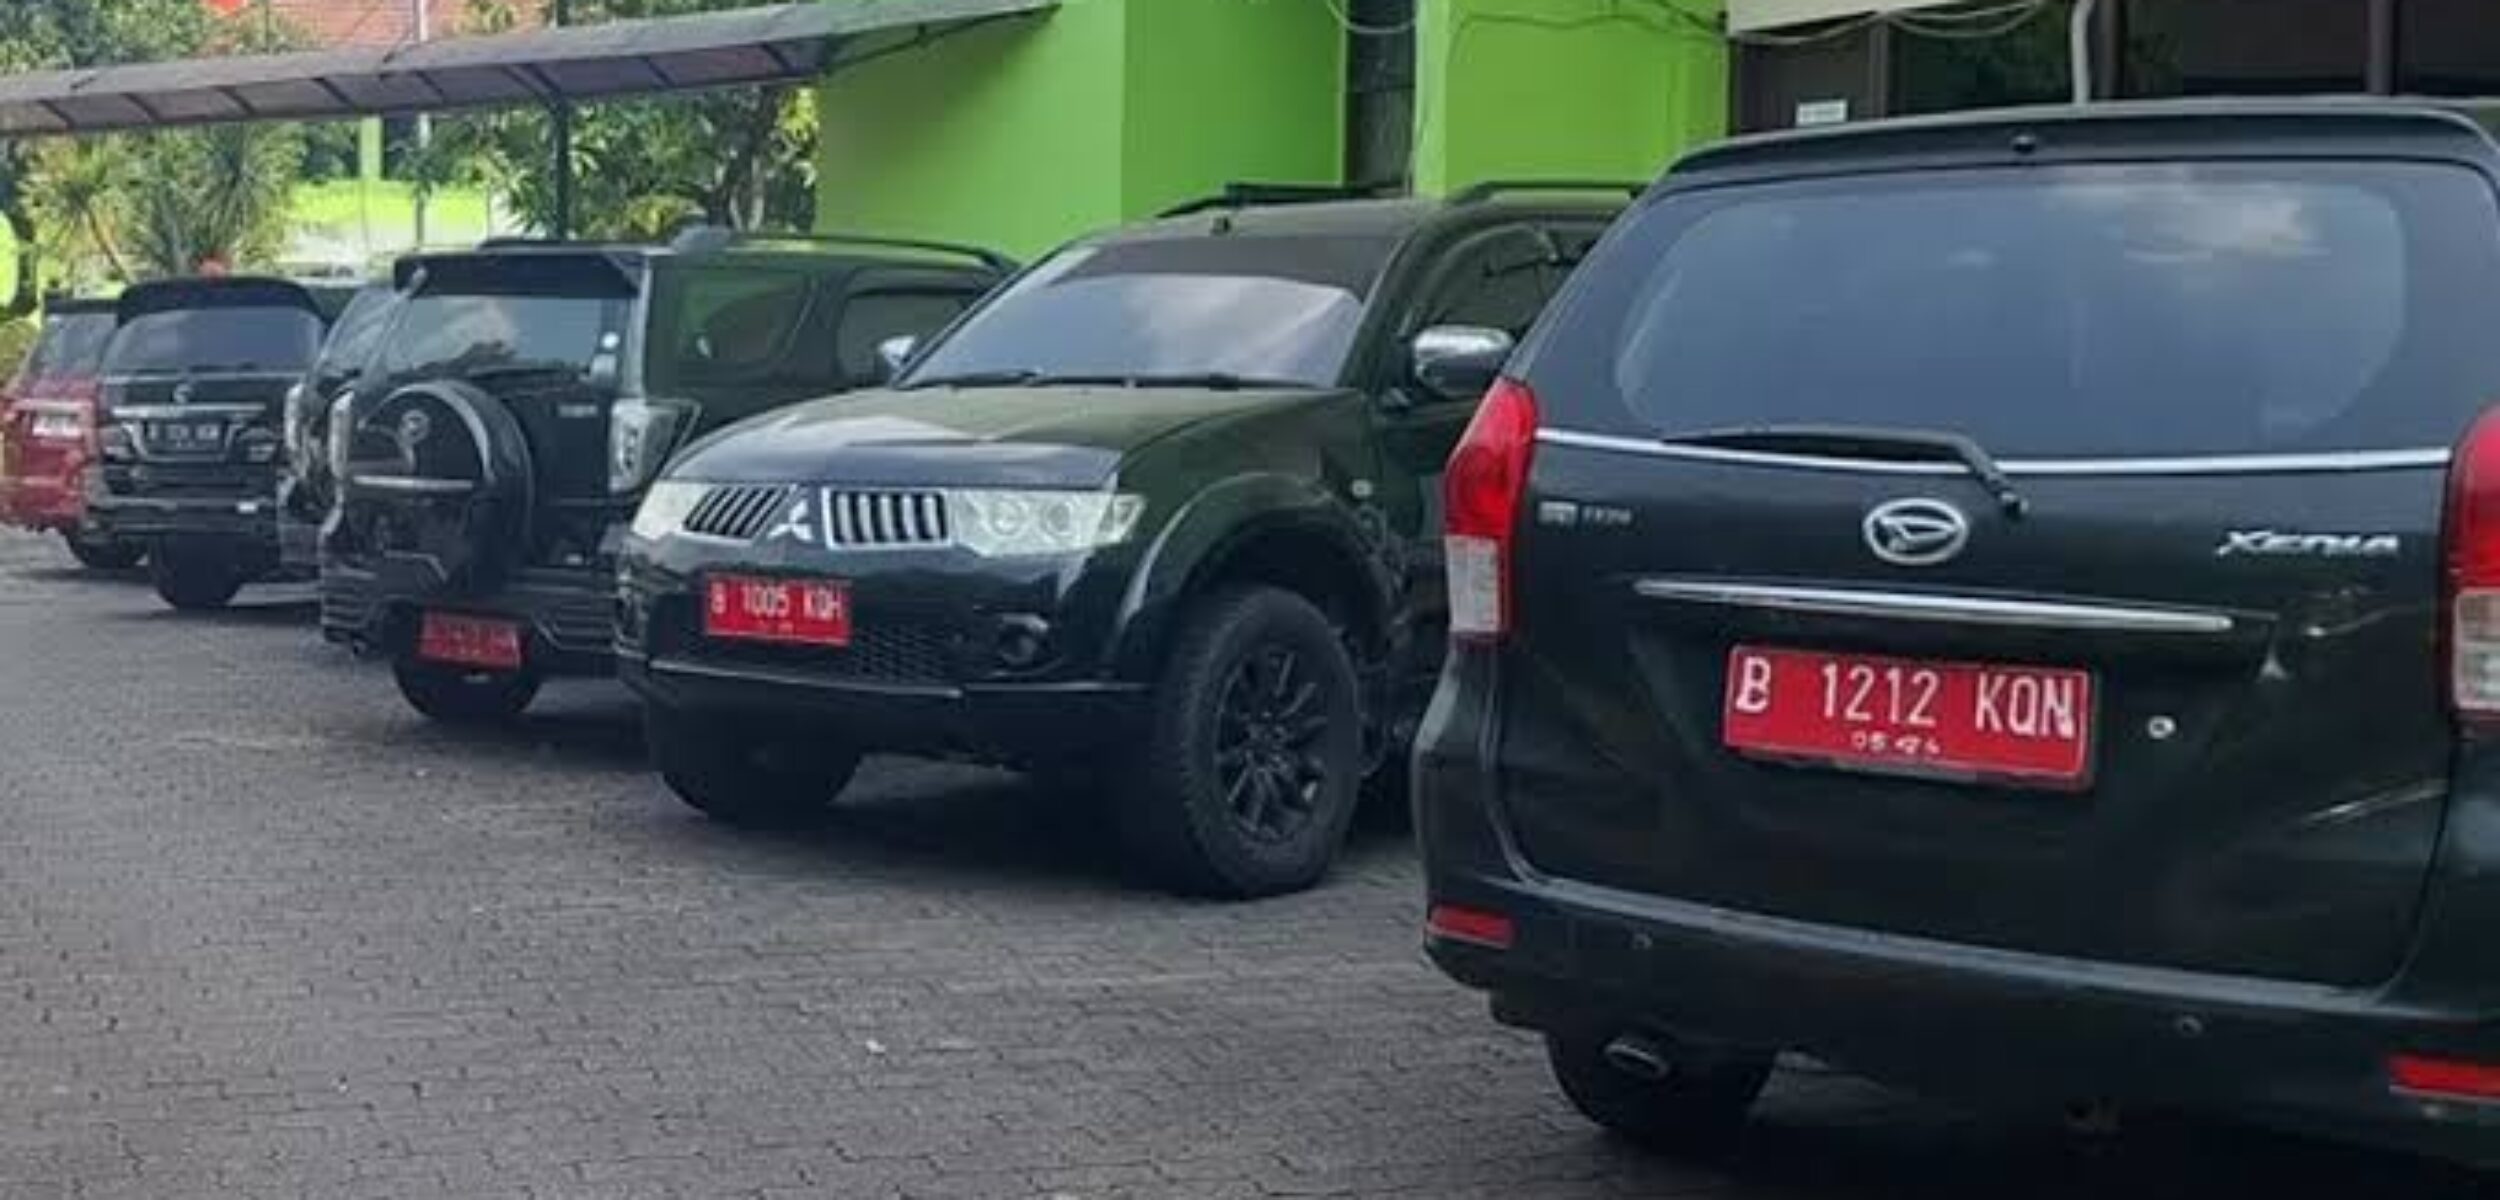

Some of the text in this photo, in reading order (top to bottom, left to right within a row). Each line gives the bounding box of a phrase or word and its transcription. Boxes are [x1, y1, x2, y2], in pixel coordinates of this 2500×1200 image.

[711, 582, 727, 614] B
[741, 585, 790, 618] 1005
[1735, 656, 2076, 739] B 1212 KQN
